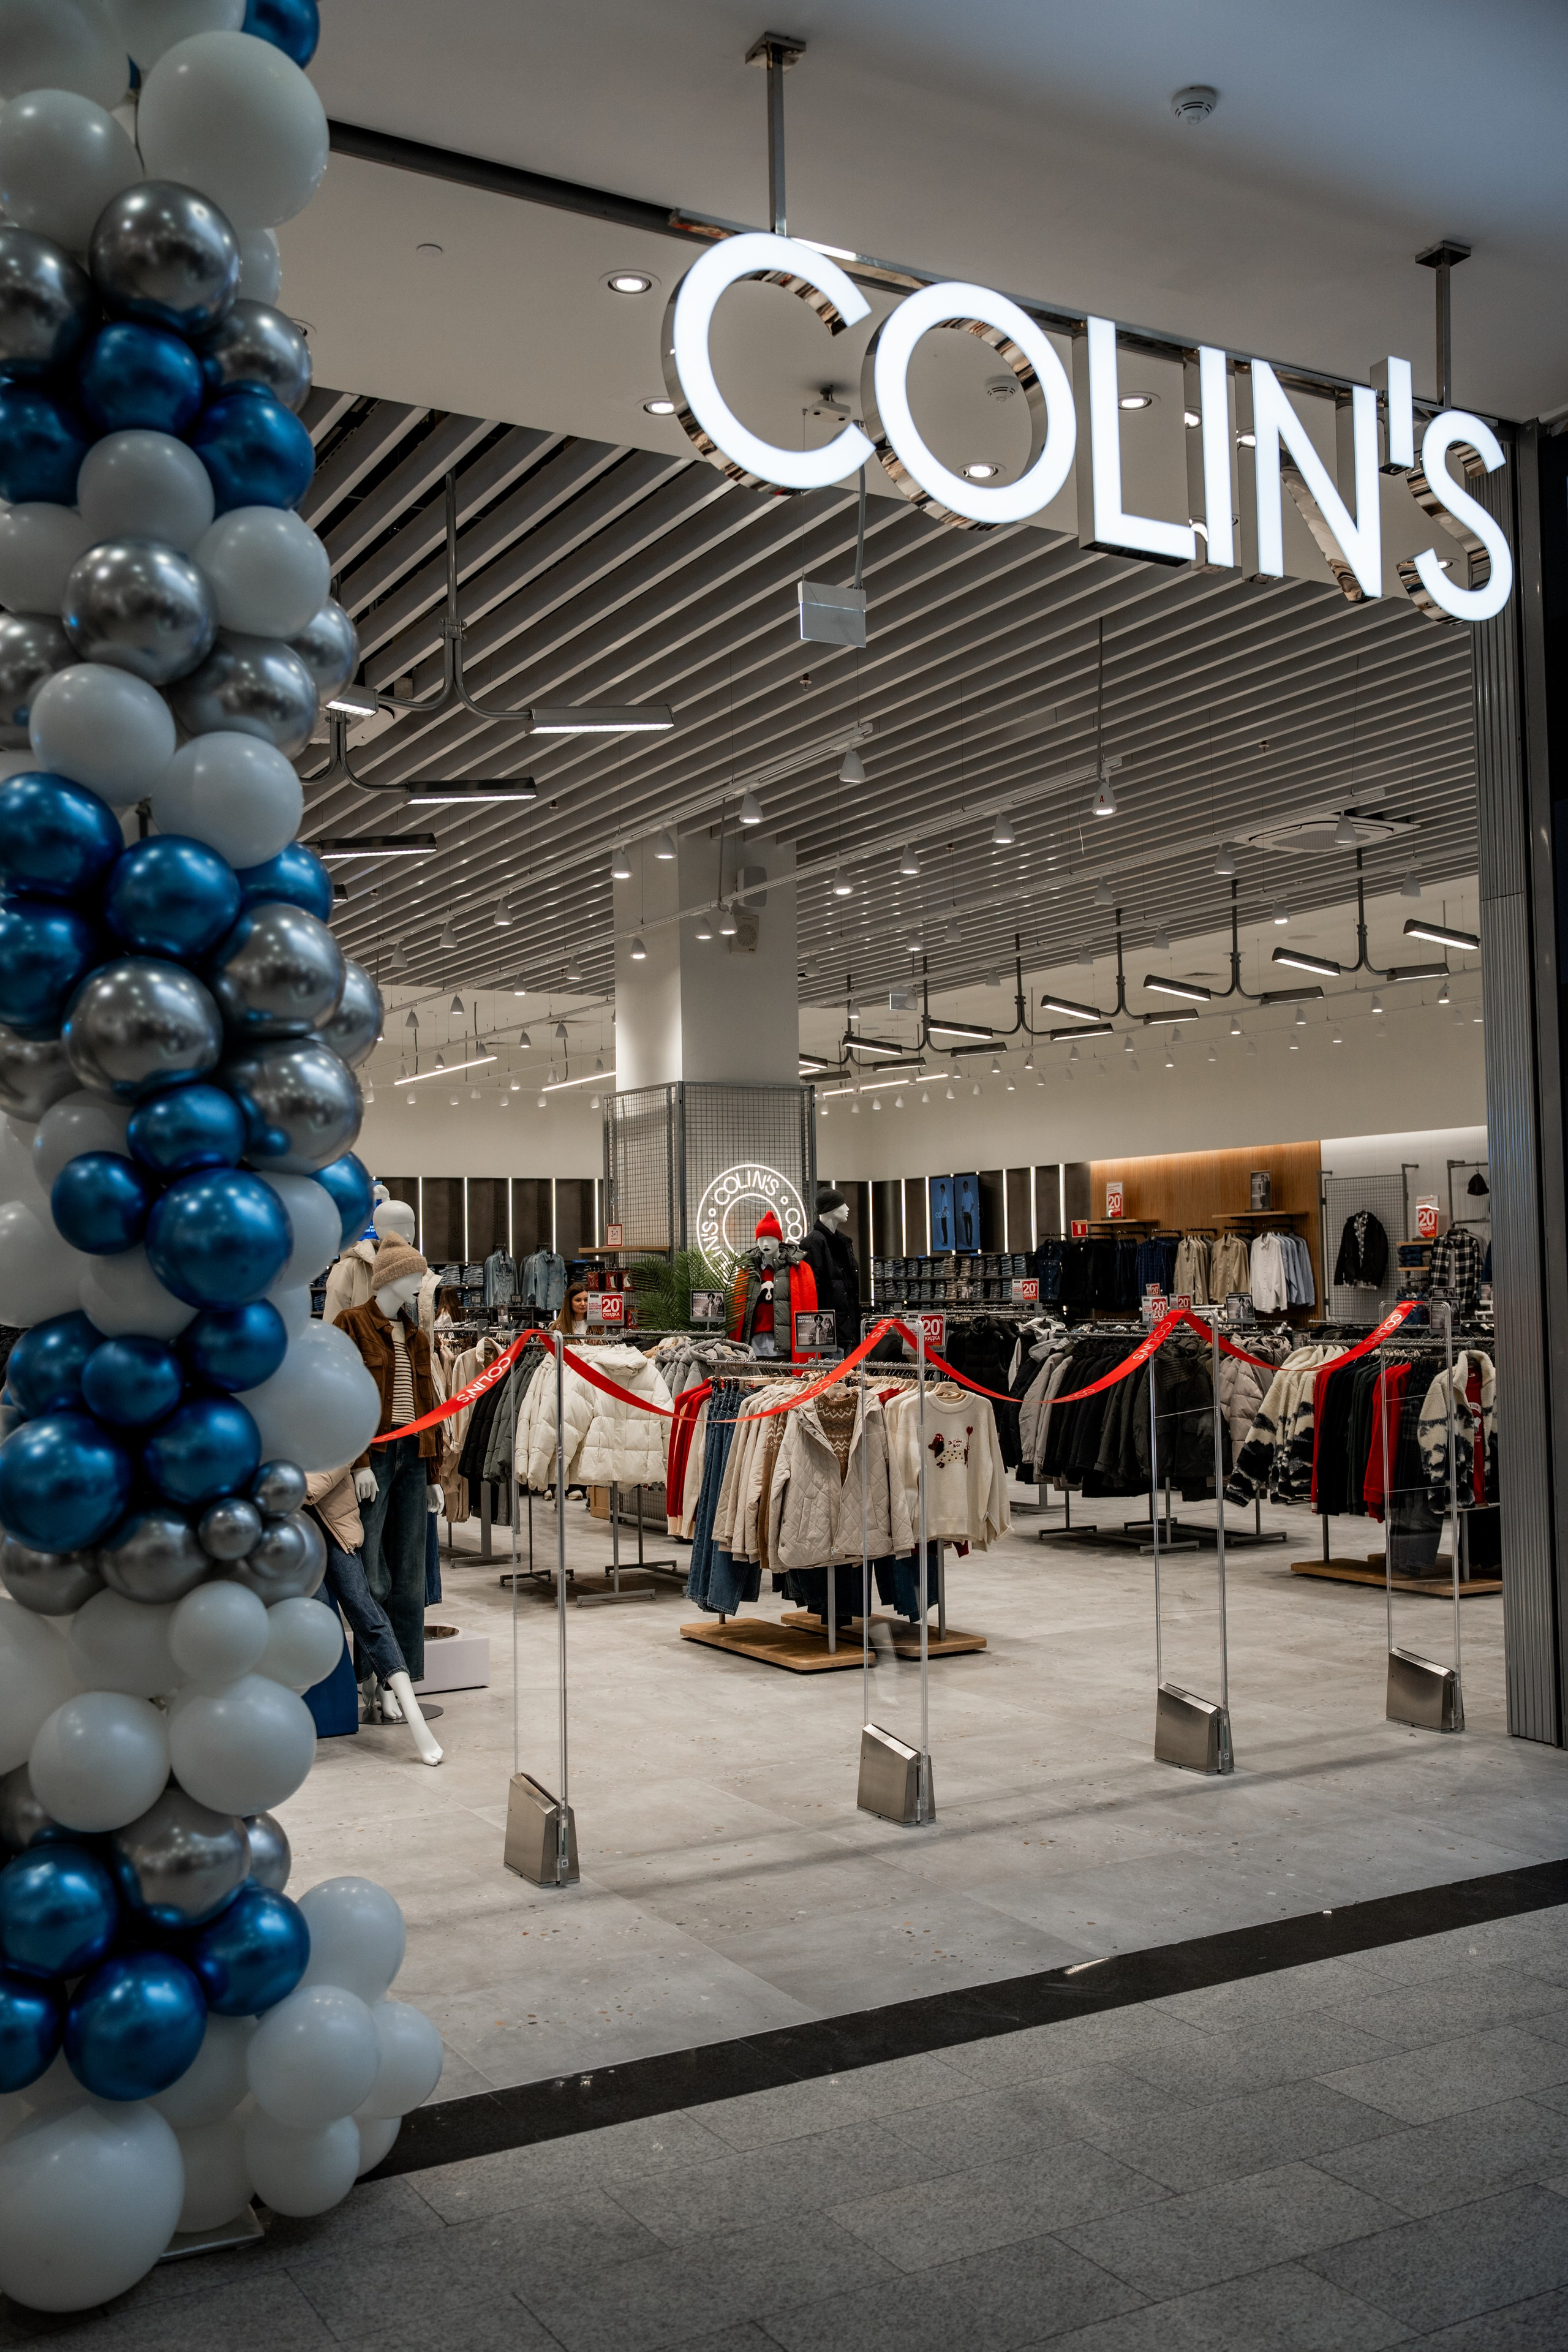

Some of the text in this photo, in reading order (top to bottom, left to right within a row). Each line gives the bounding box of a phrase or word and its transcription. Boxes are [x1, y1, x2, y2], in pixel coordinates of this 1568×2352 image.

[672, 232, 1513, 620] COLIN'S
[714, 1170, 779, 1205] COLIN'S
[602, 1298, 622, 1313] 20%
[922, 1319, 943, 1336] 20%
[1133, 1322, 1172, 1360] COLIN'S
[1364, 1314, 1402, 1346] COLIN'S
[456, 1357, 511, 1403] COLIN'S
